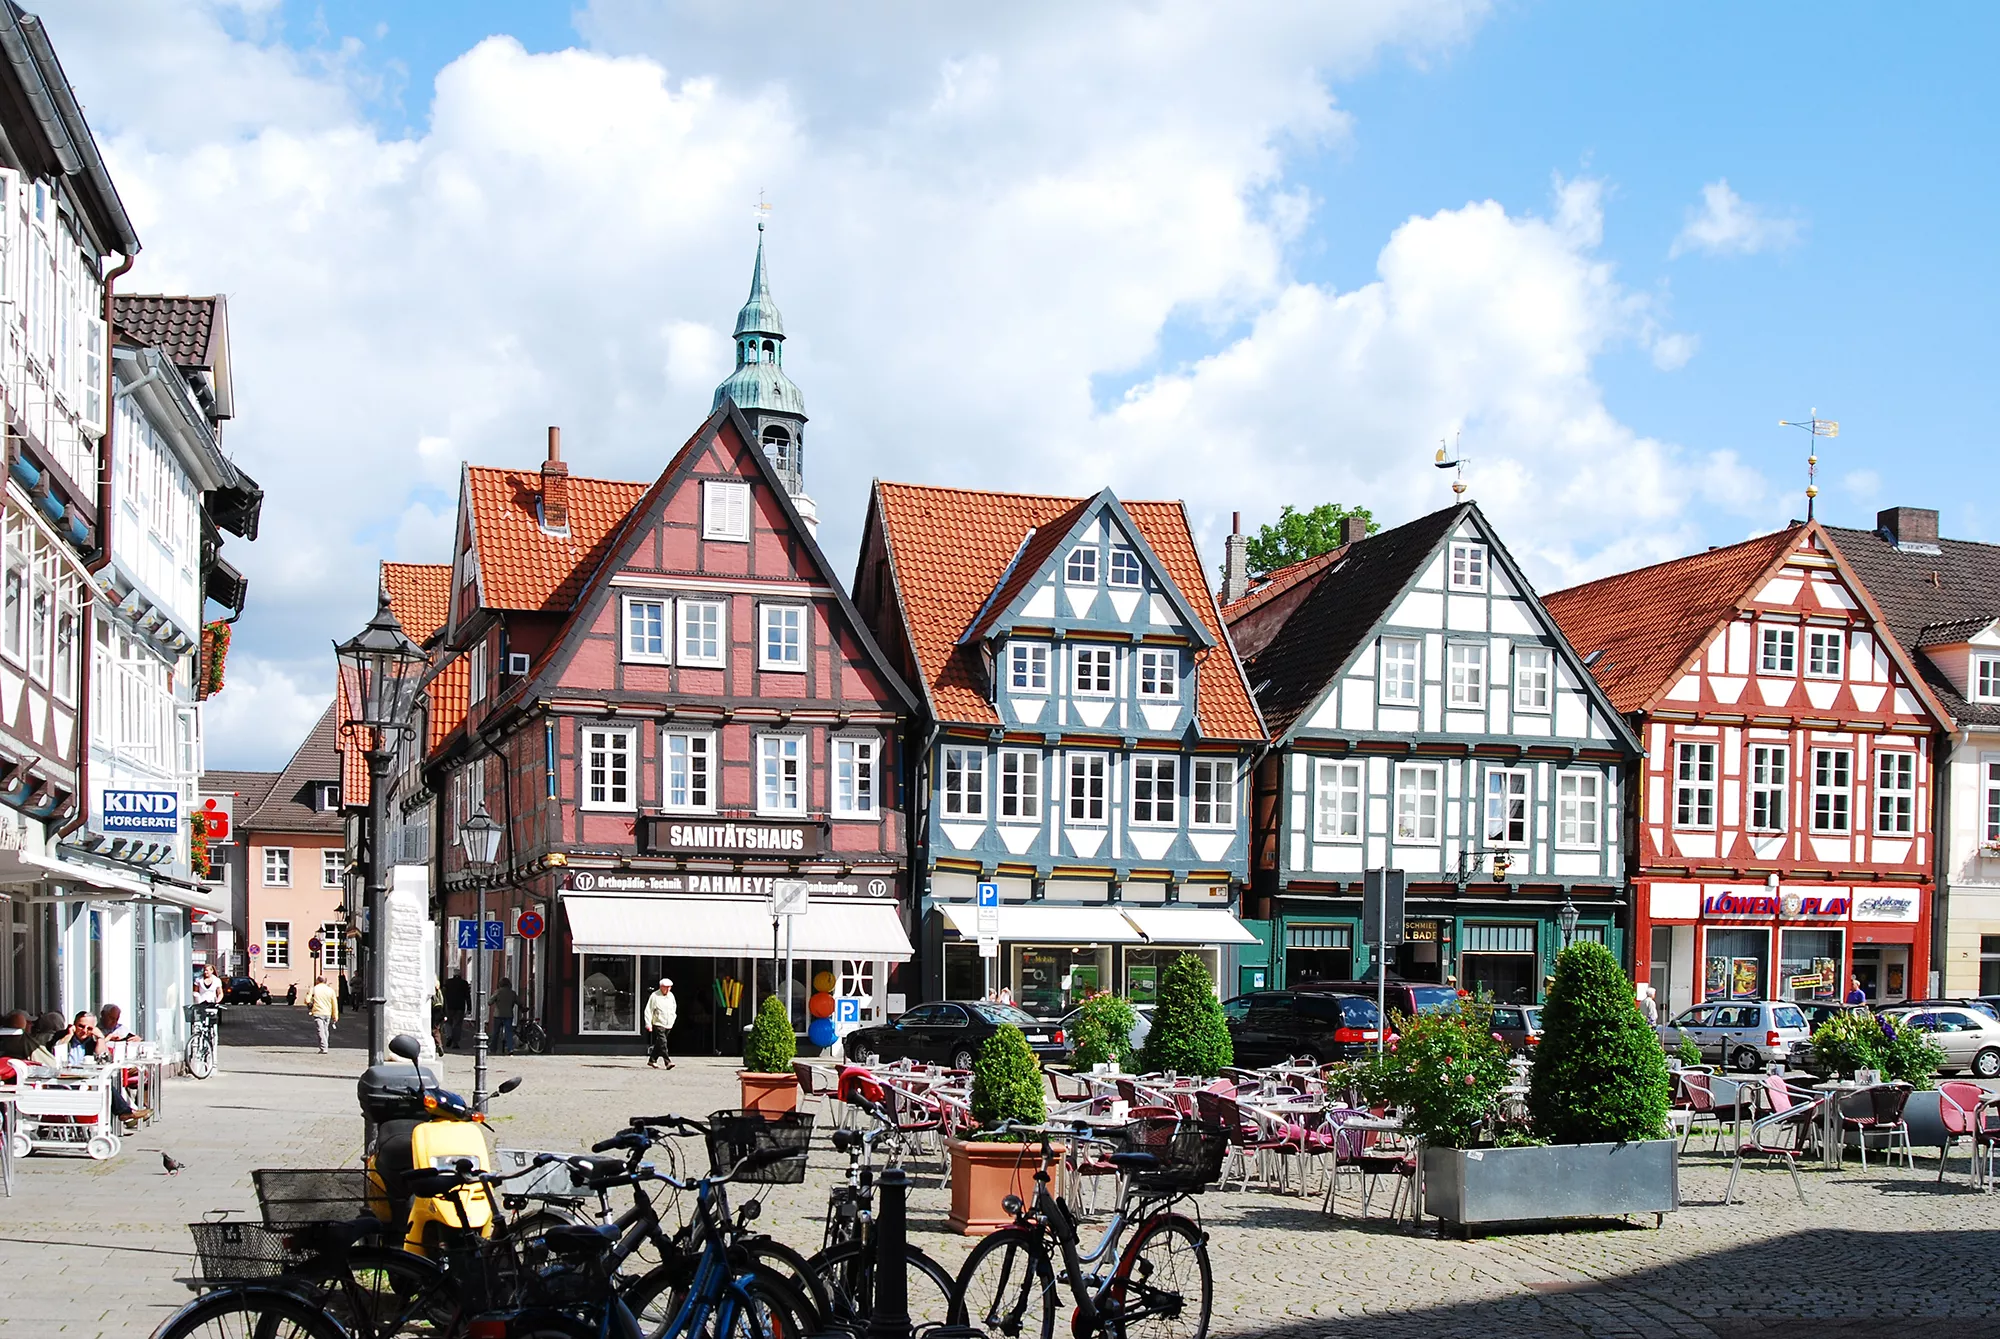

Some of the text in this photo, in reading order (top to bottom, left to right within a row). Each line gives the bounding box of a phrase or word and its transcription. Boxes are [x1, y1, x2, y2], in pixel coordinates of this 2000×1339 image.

[104, 792, 177, 813] KIND
[104, 815, 177, 828] HÖRGERÄTE
[670, 823, 804, 850] SANITÄTSHAUS
[688, 876, 784, 893] PAHMEYE
[808, 881, 859, 896] ankenpflege
[982, 885, 995, 905] P
[1705, 891, 1851, 915] LÖWEN PLAY
[841, 1001, 855, 1022] P
